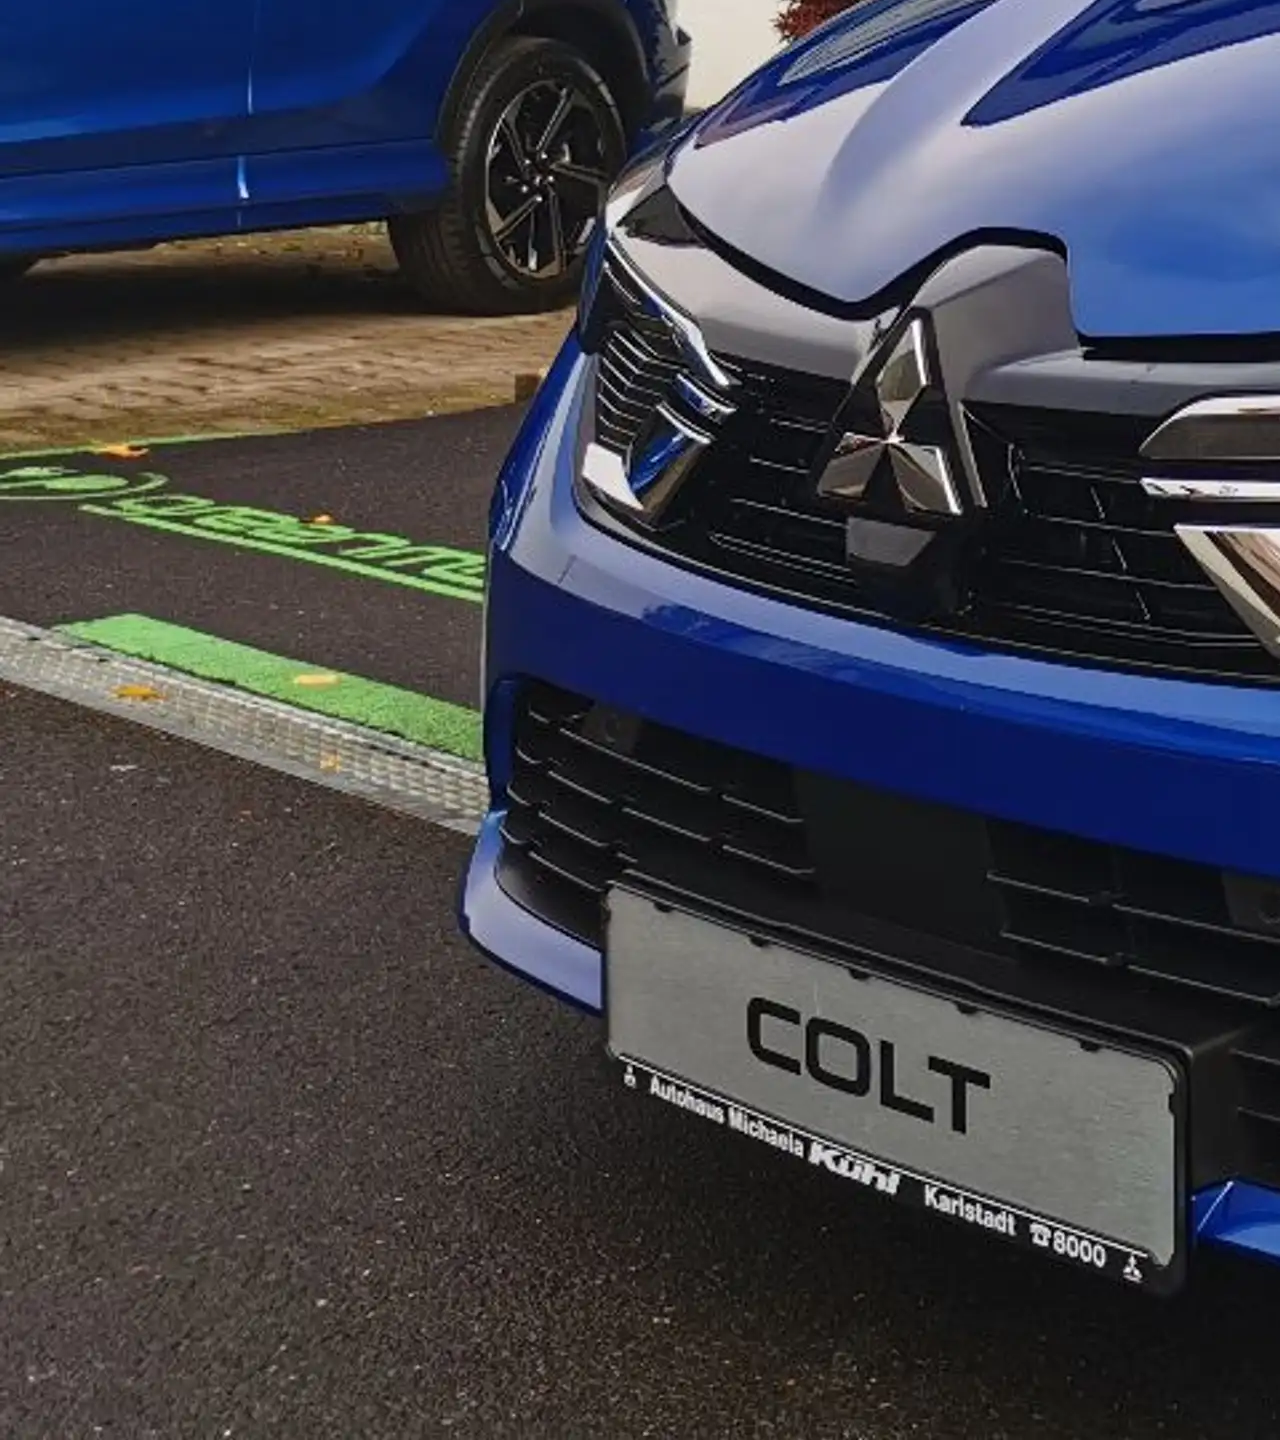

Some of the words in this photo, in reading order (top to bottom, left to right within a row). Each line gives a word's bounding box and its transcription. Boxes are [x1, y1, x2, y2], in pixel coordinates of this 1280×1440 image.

[746, 997, 990, 1135] COLT
[650, 1074, 725, 1125] Autohaus
[727, 1106, 805, 1158] Michaela
[807, 1141, 900, 1195] Kühl
[924, 1184, 1017, 1236] Karlstadt
[1053, 1231, 1106, 1268] 8000
